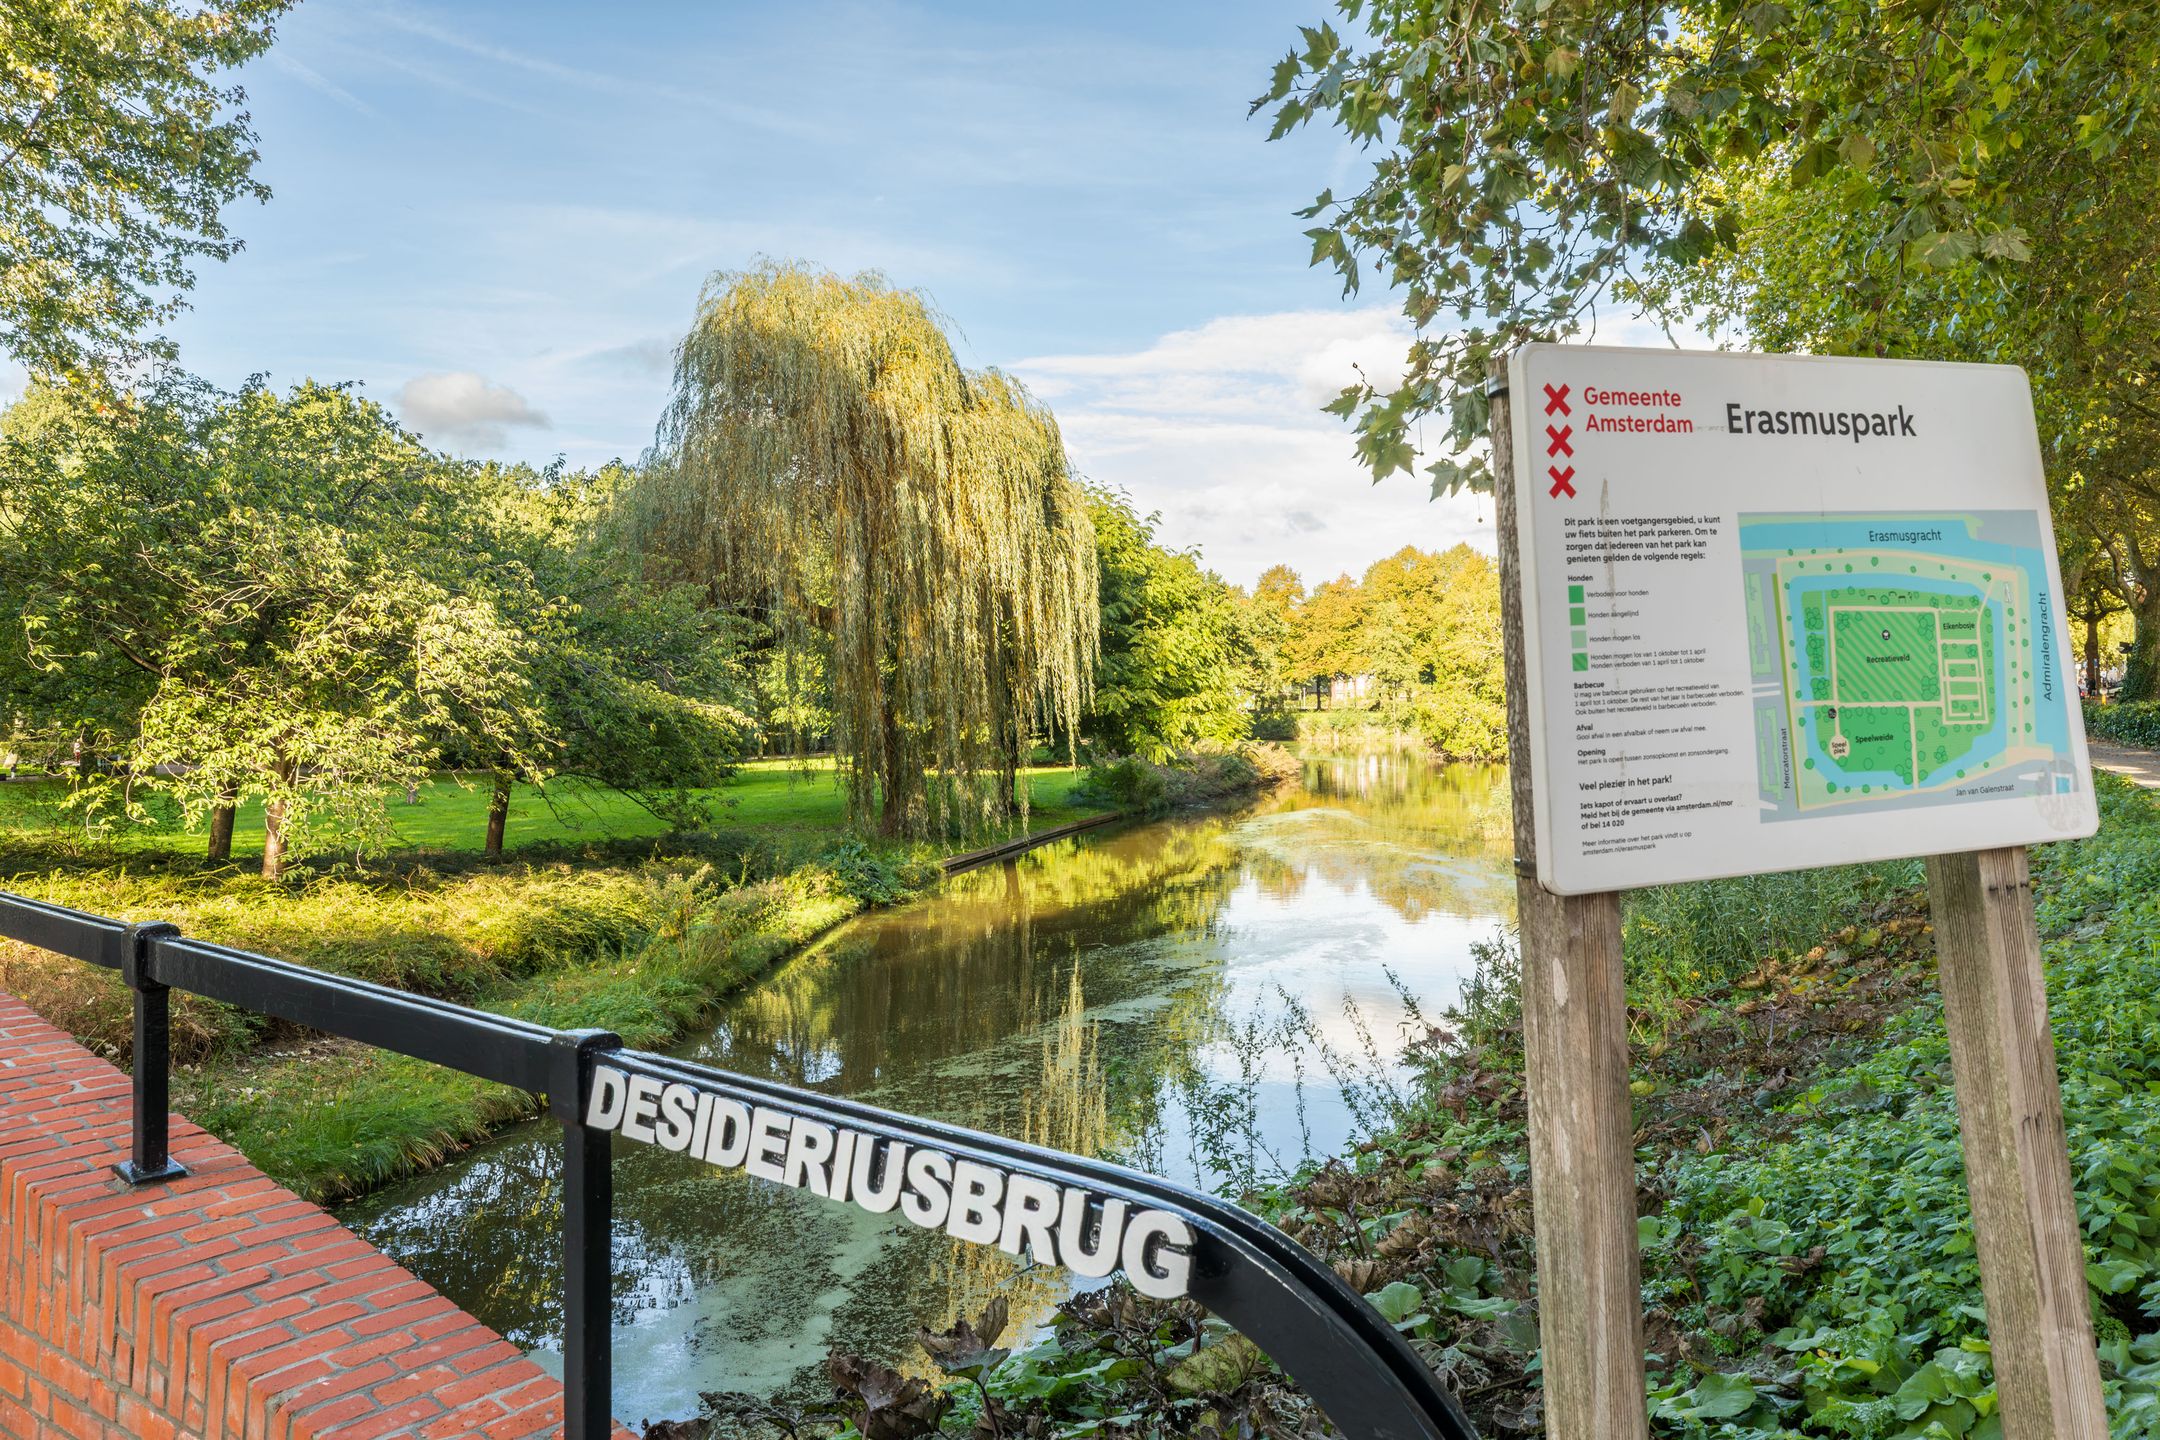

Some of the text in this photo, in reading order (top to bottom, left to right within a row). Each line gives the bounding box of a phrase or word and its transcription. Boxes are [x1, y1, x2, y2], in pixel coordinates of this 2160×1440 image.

[1584, 387, 1682, 407] Gemeente
[1585, 413, 1693, 433] Amsterdam
[1726, 403, 1917, 443] Erasmuspark
[1578, 518, 1595, 527] park
[1621, 516, 1696, 526] voetgangersgebied,
[1639, 529, 1655, 538] park
[1658, 529, 1693, 537] parkeren.
[1869, 529, 1941, 544] Erasmusgracht
[1566, 543, 1593, 552] zorgen
[1609, 541, 1644, 549] iedereen
[1675, 540, 1691, 549] park
[1567, 554, 1601, 564] genieten
[1603, 553, 1630, 563] gelden
[1644, 552, 1678, 562] volgende
[1681, 551, 1706, 560] regels:
[1943, 622, 1975, 630] Eikenbosje
[2041, 592, 2052, 701] Admiralengracht
[1866, 654, 1910, 663] Recreatieveld
[1629, 687, 1656, 696] gebruiken
[1676, 683, 1709, 691] recreatieveld
[1617, 704, 1651, 713] recreatieveld
[1855, 734, 1893, 744] Speelweide
[1578, 748, 1606, 758] Opening
[1781, 728, 1790, 788] Mercatorstraat
[1589, 757, 1602, 766] park
[1580, 782, 1597, 790] Veel
[1599, 779, 1626, 790] plezier
[1637, 777, 1650, 786] het
[1652, 775, 1672, 786] park!
[1955, 788, 1965, 796] Jan
[1980, 784, 2014, 794] Galenstraat
[1595, 800, 1614, 809] kapot
[1624, 797, 1647, 806] ervaart
[1654, 794, 1682, 803] overlast?
[1611, 809, 1620, 817] bij
[1632, 806, 1664, 816] gemeente
[1676, 799, 1733, 811] amsterdam.nl/mor
[1598, 837, 1626, 845] informatie
[1651, 833, 1664, 842] park
[586, 1064, 1198, 1300] DESIDERIUSBRUG
